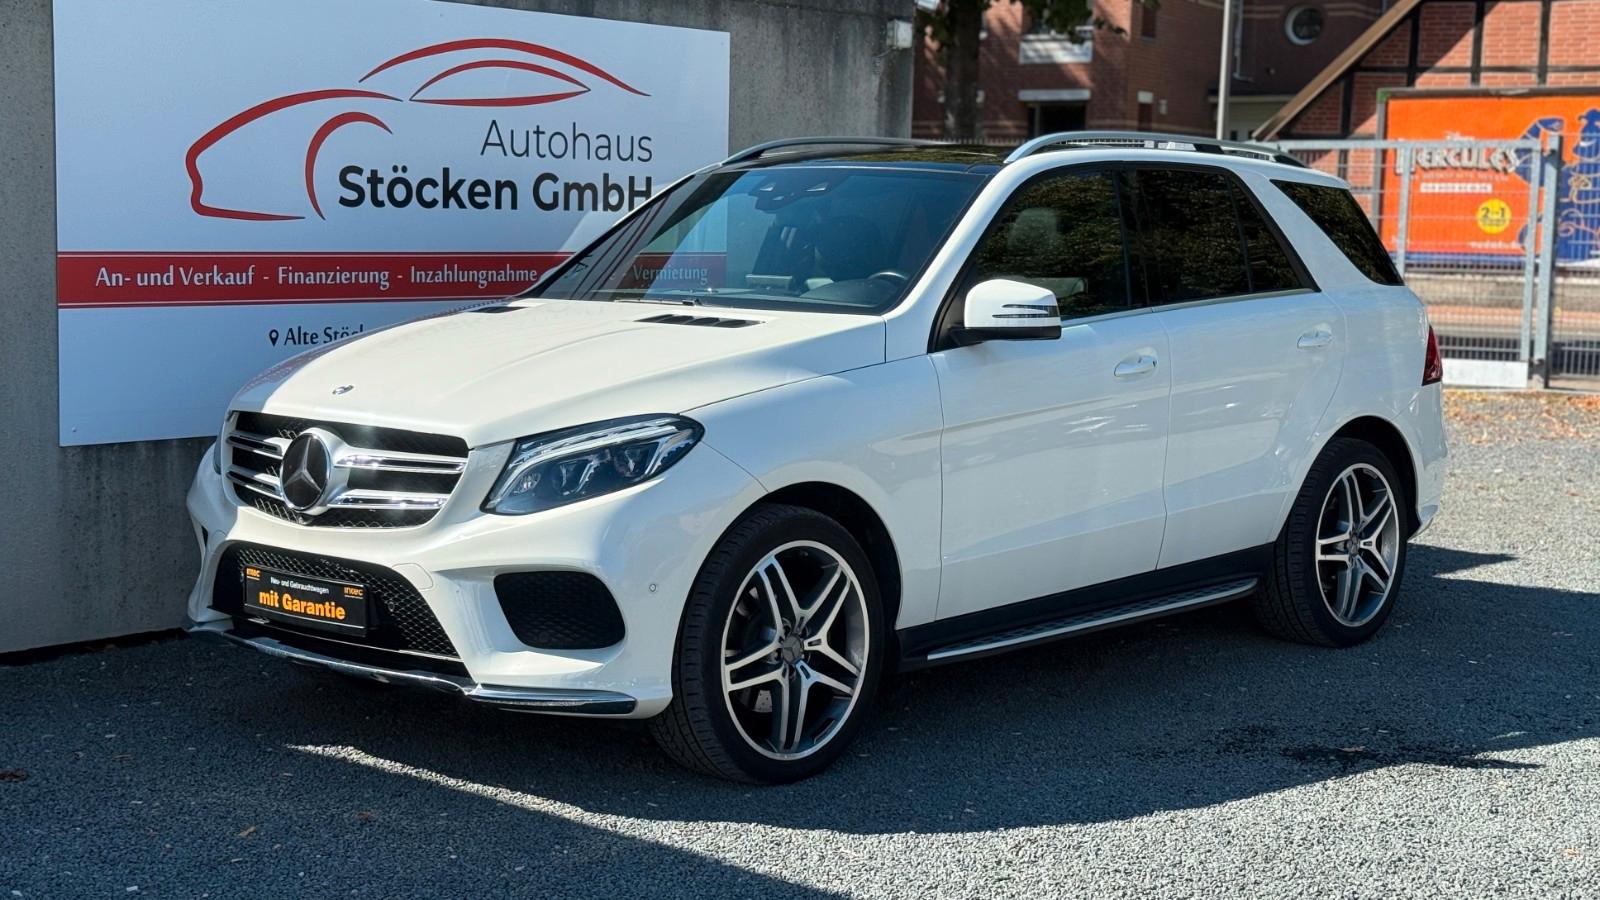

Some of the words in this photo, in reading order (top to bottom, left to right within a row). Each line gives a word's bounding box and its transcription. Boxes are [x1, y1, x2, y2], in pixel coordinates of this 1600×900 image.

[480, 119, 653, 163] Autohaus
[338, 165, 518, 210] Stöcken
[532, 172, 652, 212] GmbH
[95, 266, 131, 287] An-
[137, 265, 174, 286] und
[179, 264, 255, 286] Verkauf
[278, 266, 390, 290] Finanzierung
[411, 263, 537, 290] Inzahlungnahme
[633, 264, 709, 286] Vermietung
[284, 325, 319, 346] Alte
[281, 579, 290, 587] und
[259, 590, 279, 608] mit
[282, 593, 346, 620] Garantie
